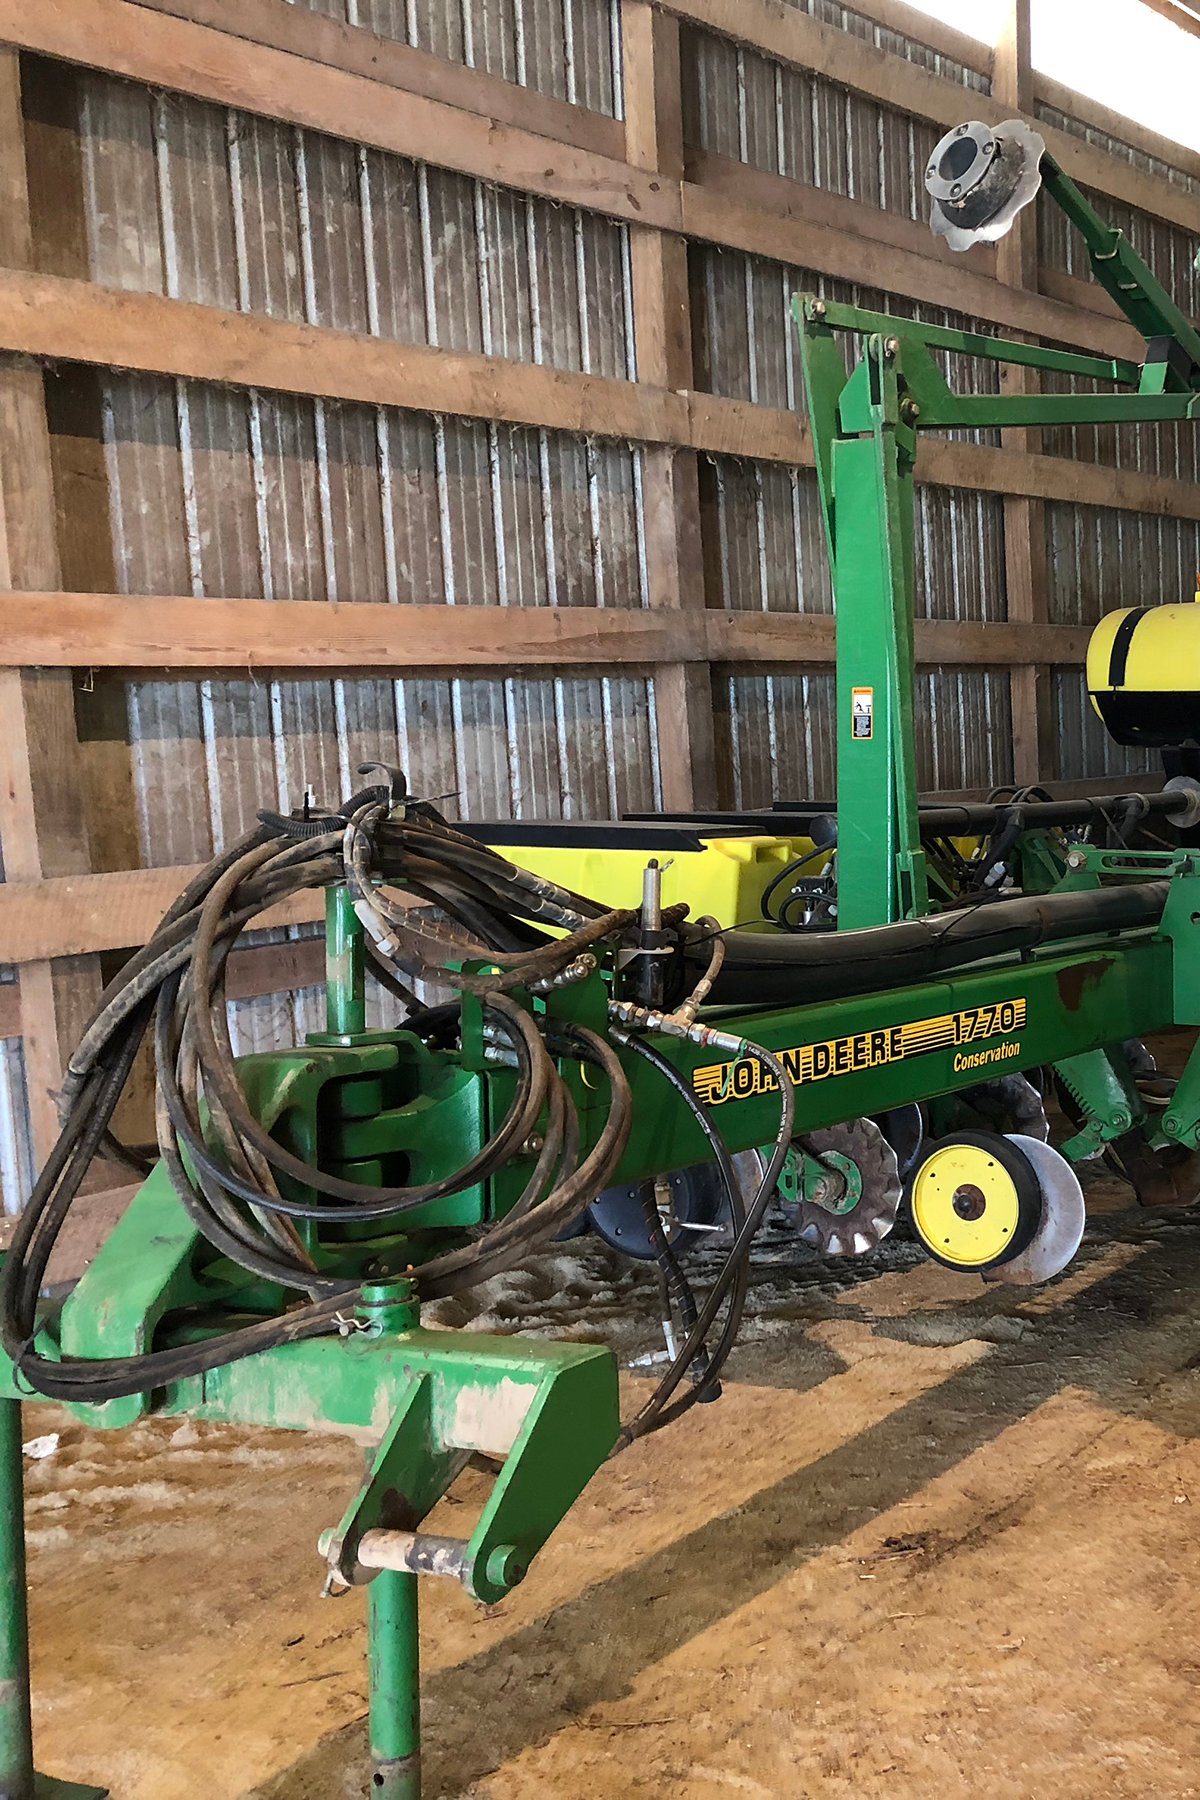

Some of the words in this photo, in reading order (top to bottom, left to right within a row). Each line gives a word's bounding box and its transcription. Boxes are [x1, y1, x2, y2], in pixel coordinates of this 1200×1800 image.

[812, 1029, 905, 1081] DEERE
[952, 1002, 1016, 1045] 1770
[953, 1041, 1021, 1073] Conservation
